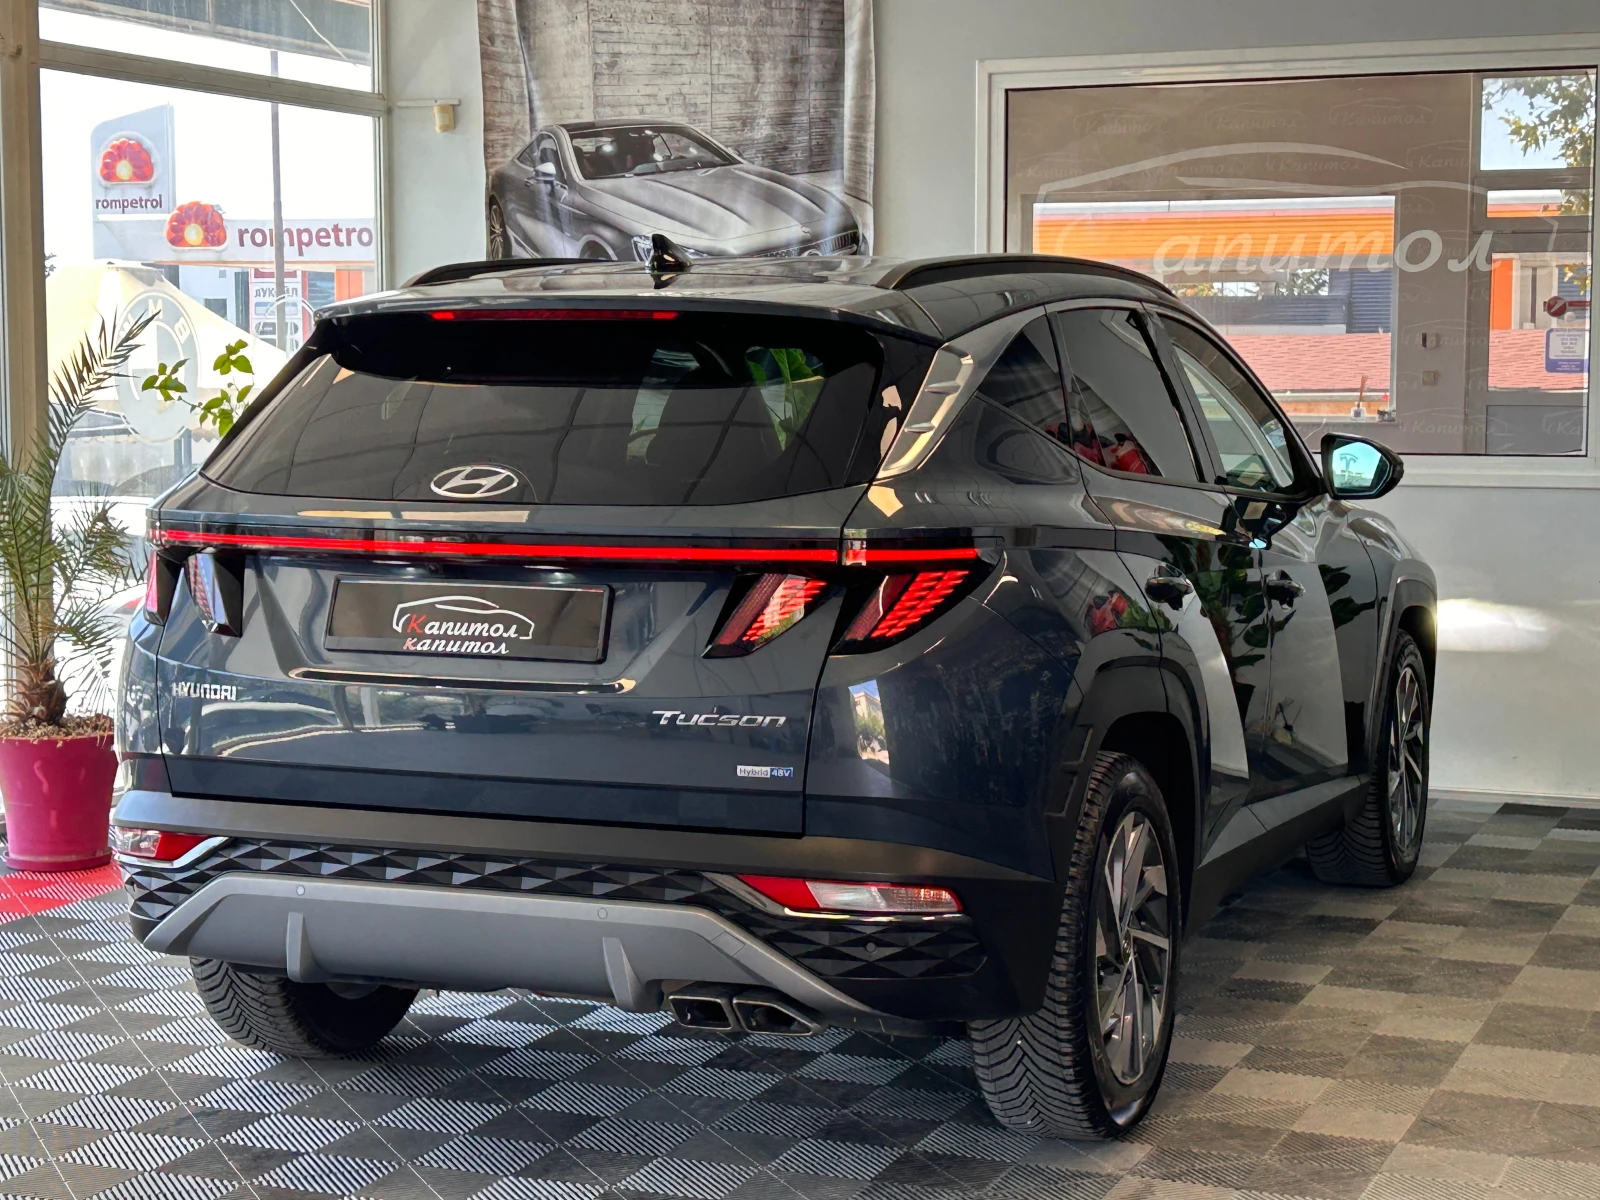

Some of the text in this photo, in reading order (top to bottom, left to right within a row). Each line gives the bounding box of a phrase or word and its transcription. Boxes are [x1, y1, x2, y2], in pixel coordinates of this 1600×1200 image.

[95, 194, 163, 214] rompetrol
[237, 223, 374, 257] rompetro
[1152, 230, 1501, 275] апитол
[171, 681, 237, 701] HYUNDAI
[739, 768, 791, 777] Hybrid 48V
